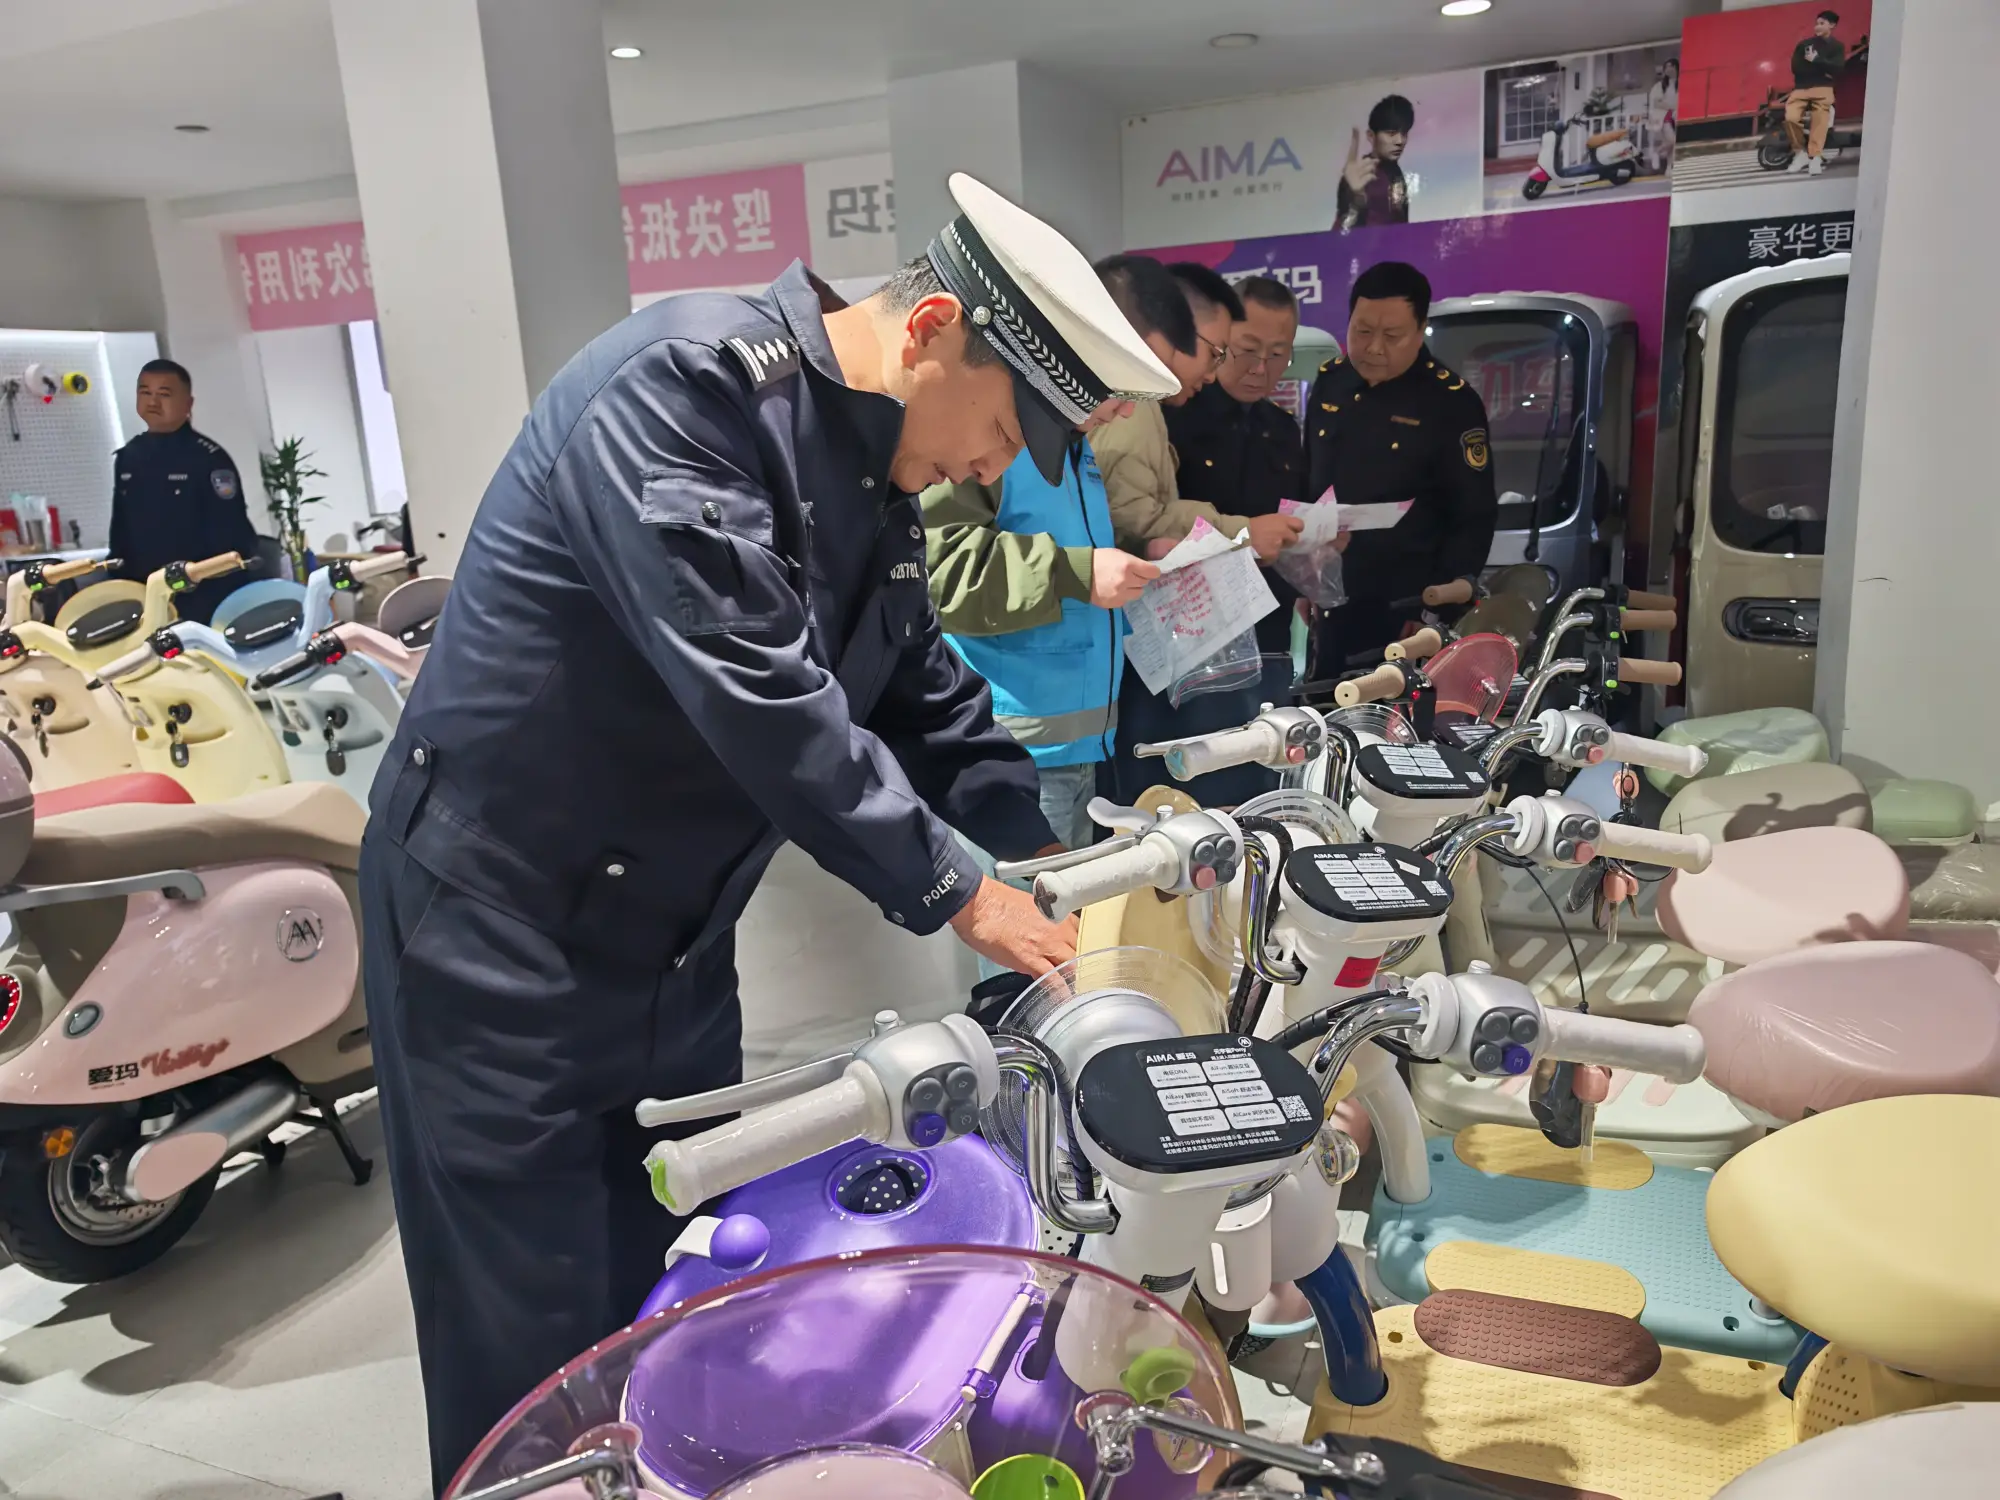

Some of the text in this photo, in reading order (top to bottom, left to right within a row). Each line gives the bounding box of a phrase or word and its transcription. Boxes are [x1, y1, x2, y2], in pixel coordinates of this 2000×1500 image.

[1156, 136, 1303, 187] AIMA
[1748, 220, 1854, 259] 豪华更
[922, 868, 959, 908] POLICE
[88, 1062, 139, 1086] 爱玛
[1146, 1054, 1175, 1063] AIMA
